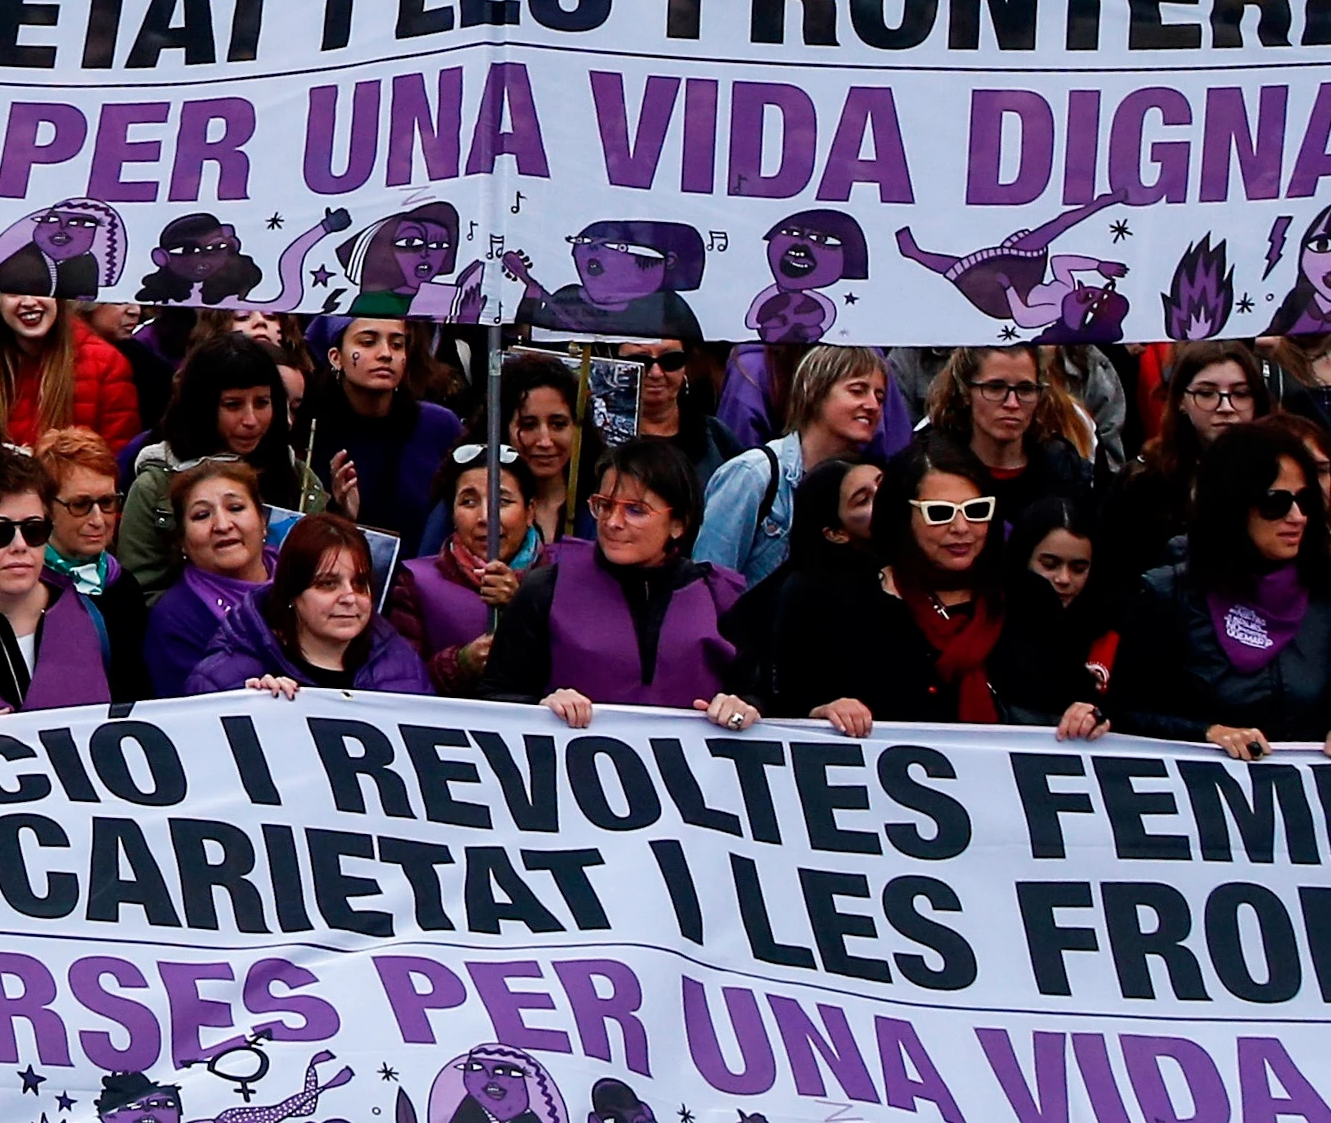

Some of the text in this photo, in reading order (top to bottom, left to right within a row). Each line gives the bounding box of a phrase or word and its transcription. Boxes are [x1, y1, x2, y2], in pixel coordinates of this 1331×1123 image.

[303, 63, 550, 196] UNA
[589, 70, 915, 204] VIDA
[221, 715, 281, 805] I
[307, 717, 972, 860] REVOLTES
[649, 840, 703, 947] I
[730, 852, 977, 991] LES
[370, 954, 653, 1077] PER
[682, 976, 965, 1123] UNA
[975, 1026, 1331, 1123] VIDA
